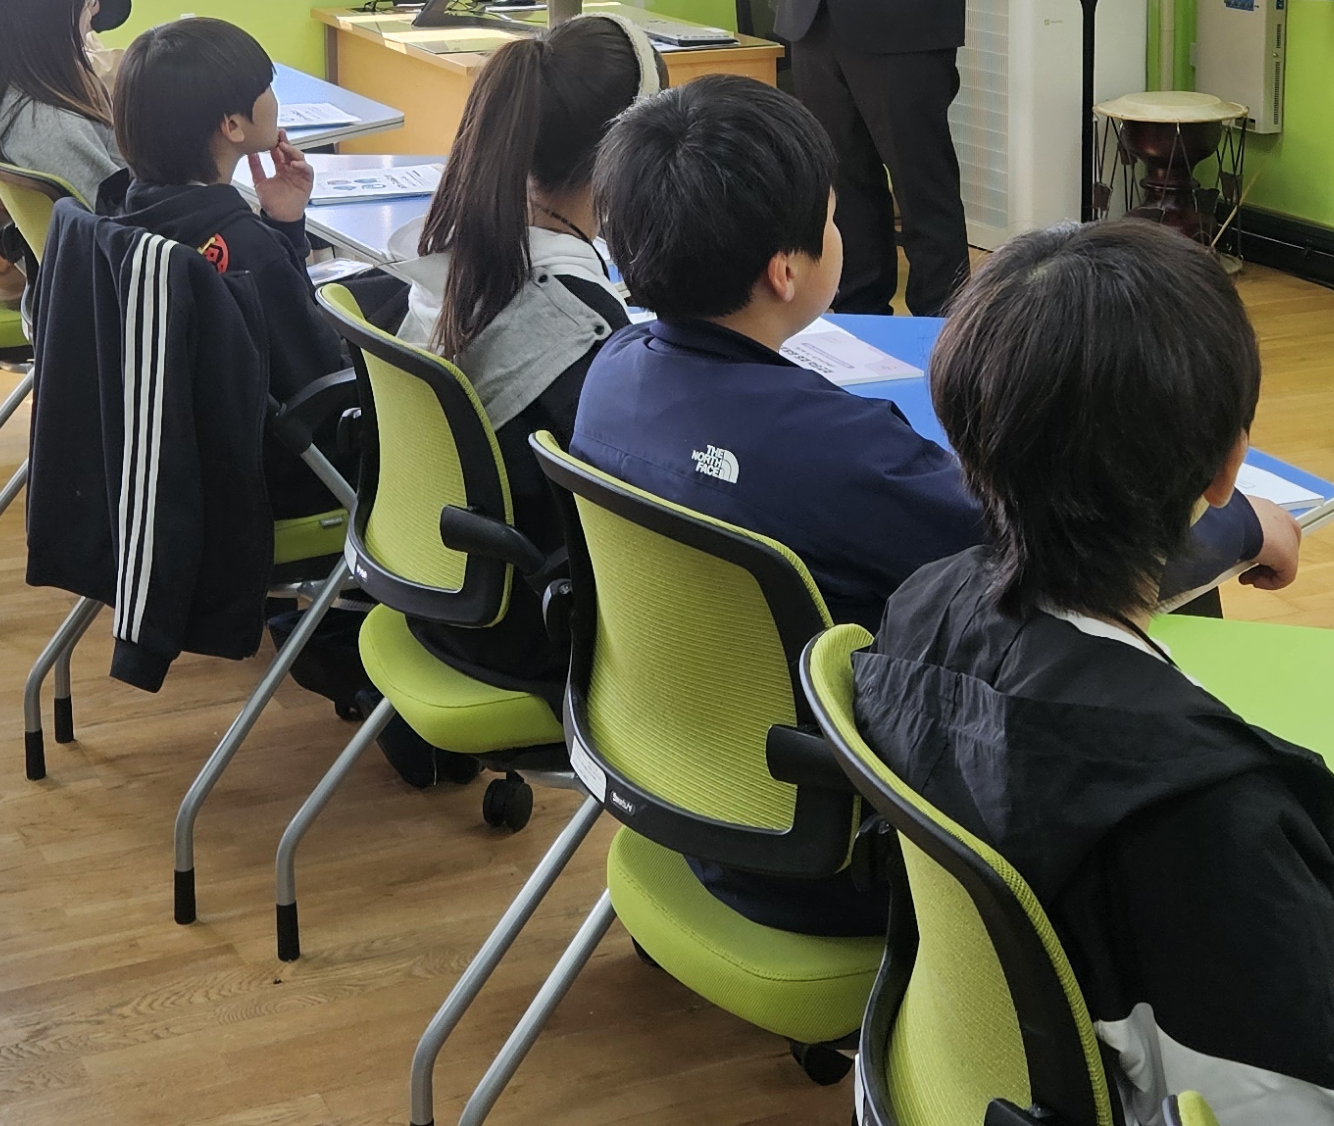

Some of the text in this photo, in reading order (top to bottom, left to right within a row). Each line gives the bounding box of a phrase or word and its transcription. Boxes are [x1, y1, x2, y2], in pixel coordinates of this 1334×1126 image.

[691, 449, 724, 468] NORTH
[707, 444, 725, 459] THE
[695, 461, 722, 478] FACE
